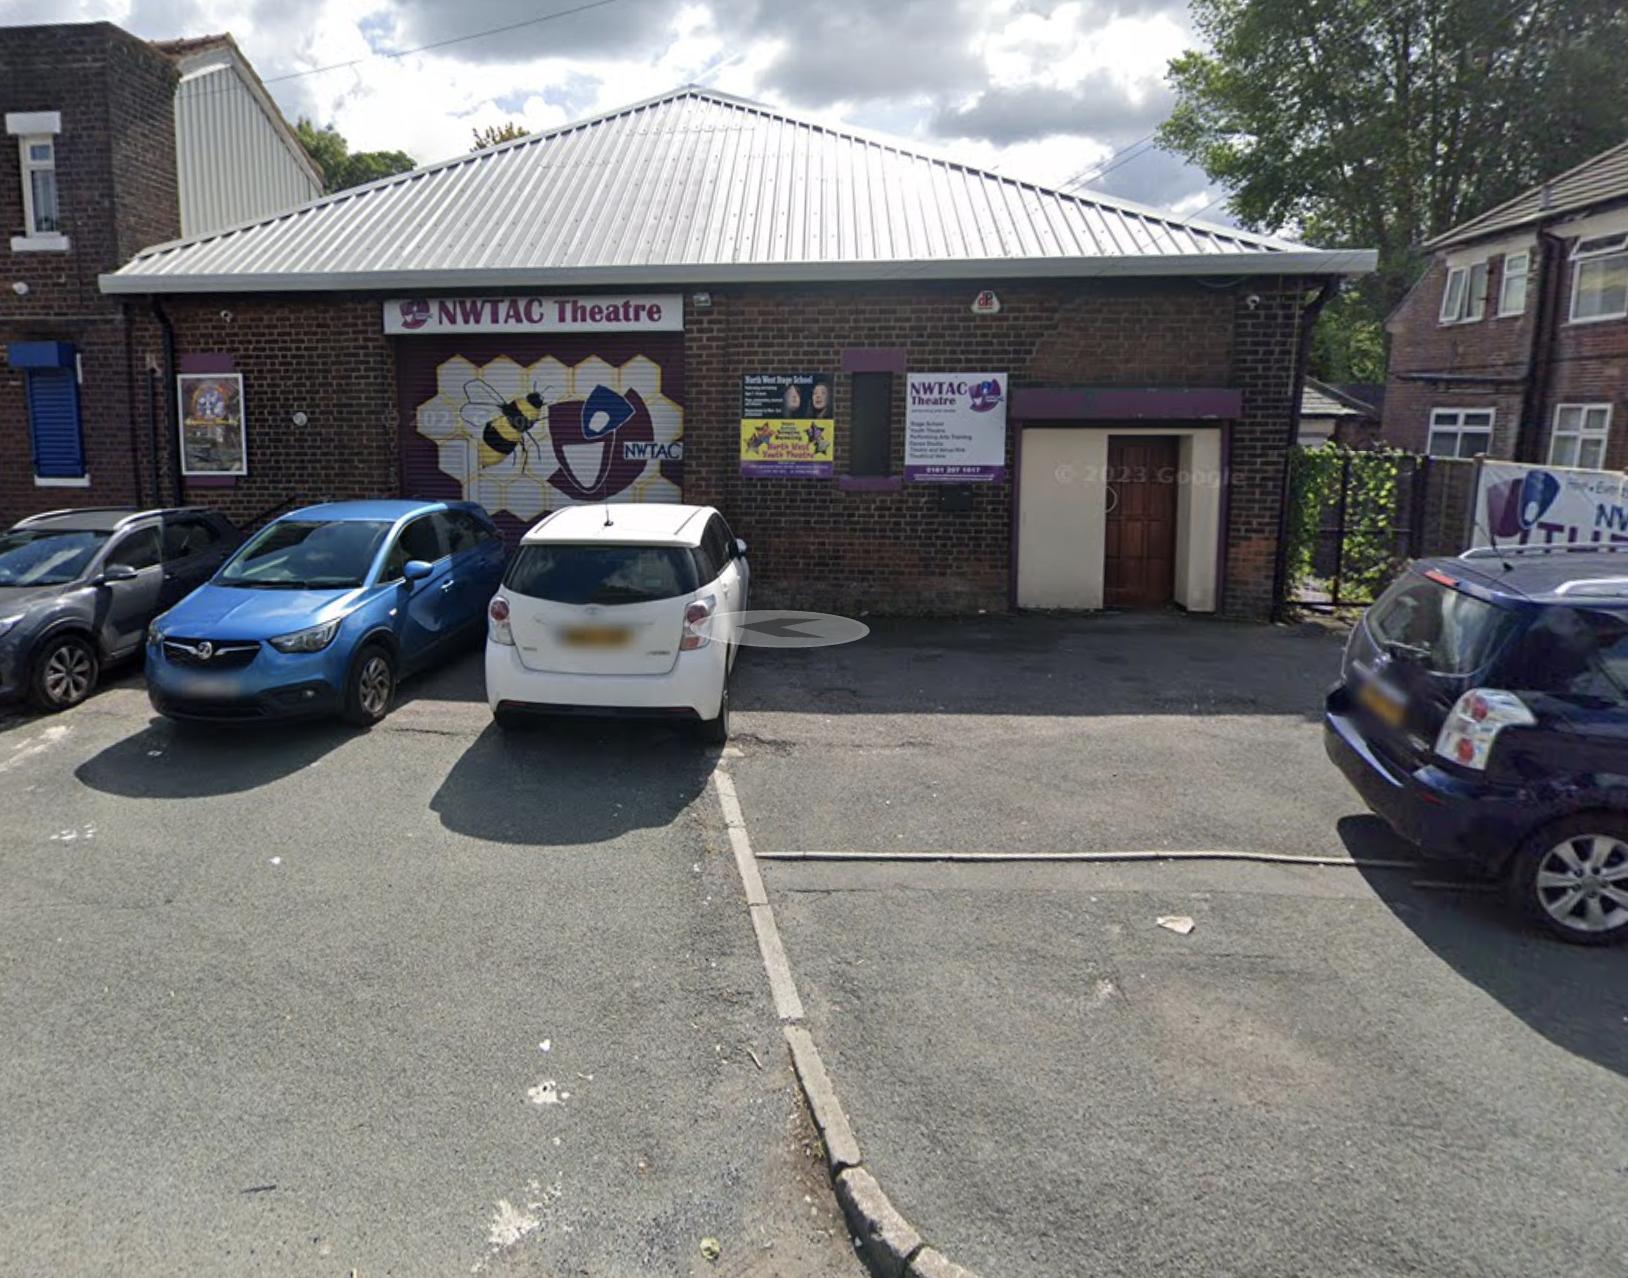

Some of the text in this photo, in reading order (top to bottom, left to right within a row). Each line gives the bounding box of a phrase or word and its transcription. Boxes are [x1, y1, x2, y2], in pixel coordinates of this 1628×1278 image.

[438, 298, 662, 325] NWTAC Theatre
[910, 382, 968, 395] NWTAC
[911, 396, 957, 406] Theatre
[625, 443, 681, 459] NWTAC
